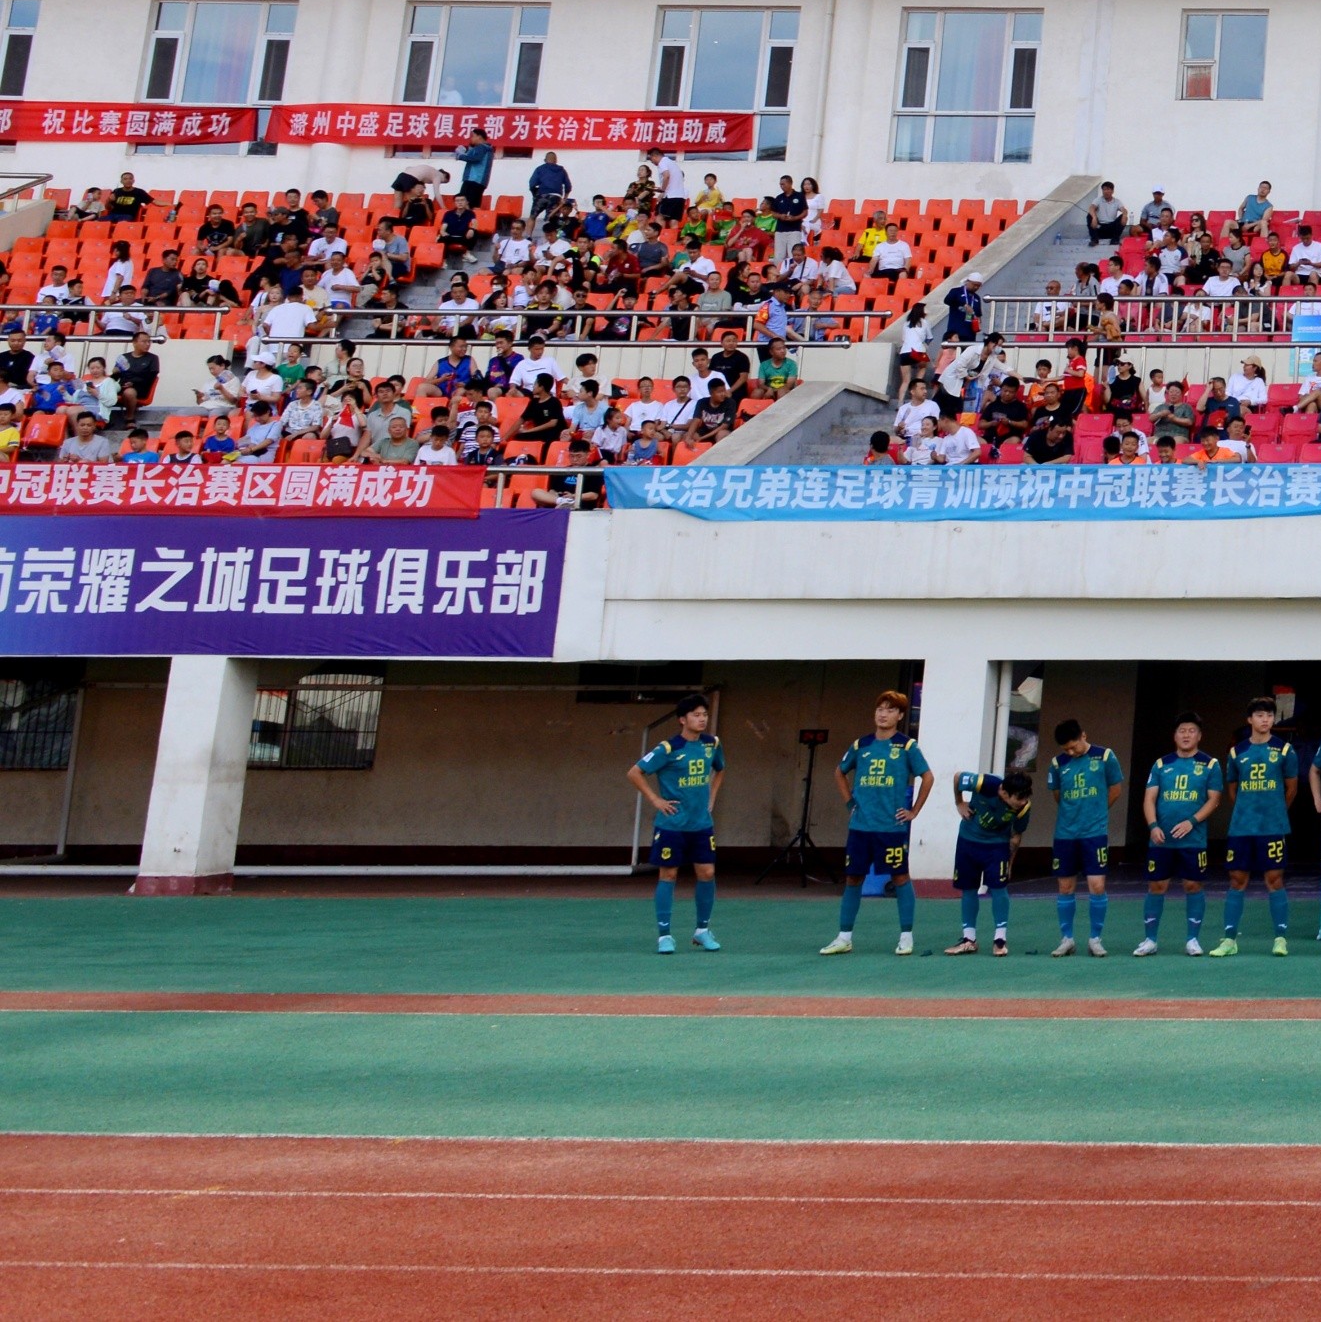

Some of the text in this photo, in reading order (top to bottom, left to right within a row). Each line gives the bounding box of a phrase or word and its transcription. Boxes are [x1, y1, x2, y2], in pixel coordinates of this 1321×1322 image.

[42, 109, 232, 137] 祝比赛圆满成功
[0, 464, 434, 508] 冠联赛长治赛区圆满成功
[0, 546, 547, 616] 荣耀之城足球俱乐部
[688, 759, 705, 775] 69
[869, 759, 886, 775] 29
[1250, 763, 1266, 779] 22
[1074, 774, 1085, 788] 16
[1174, 775, 1187, 790] 10
[885, 847, 903, 864] 29
[1268, 842, 1284, 859] 22
